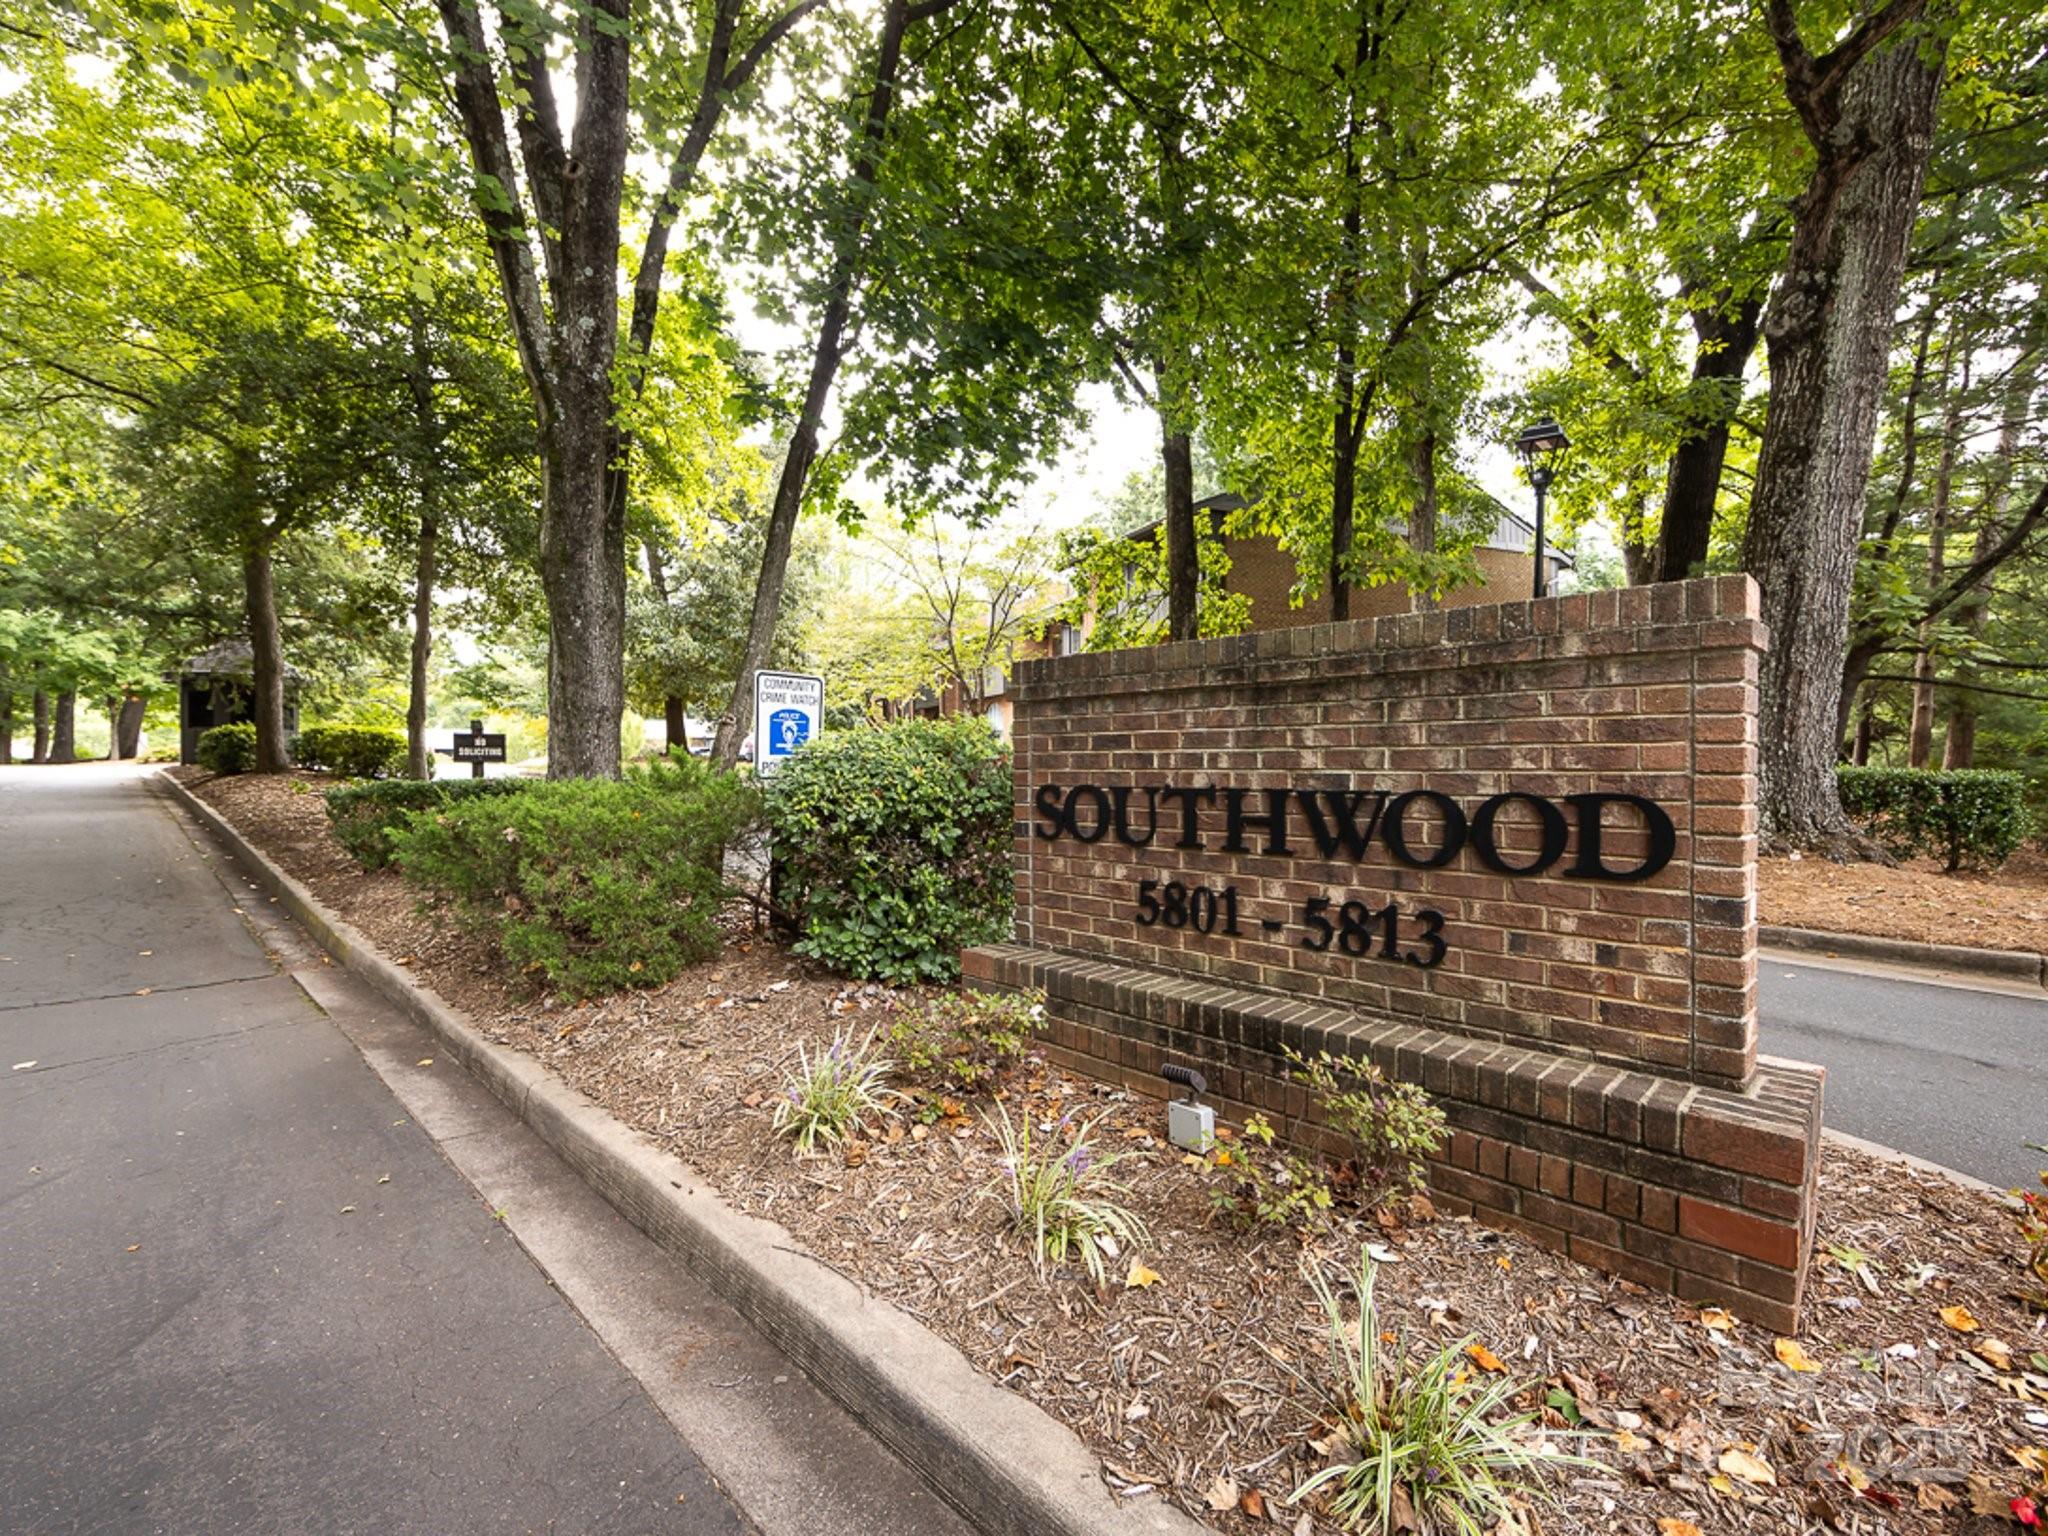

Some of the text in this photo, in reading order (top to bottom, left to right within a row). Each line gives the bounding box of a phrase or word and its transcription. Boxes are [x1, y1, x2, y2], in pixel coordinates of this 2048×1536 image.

[760, 691, 819, 706] CRIME WATCH
[764, 678, 816, 693] COMMUNITY
[1034, 783, 1677, 881] SOUTHWOOD
[1135, 879, 1449, 970] 5801 - 5813
